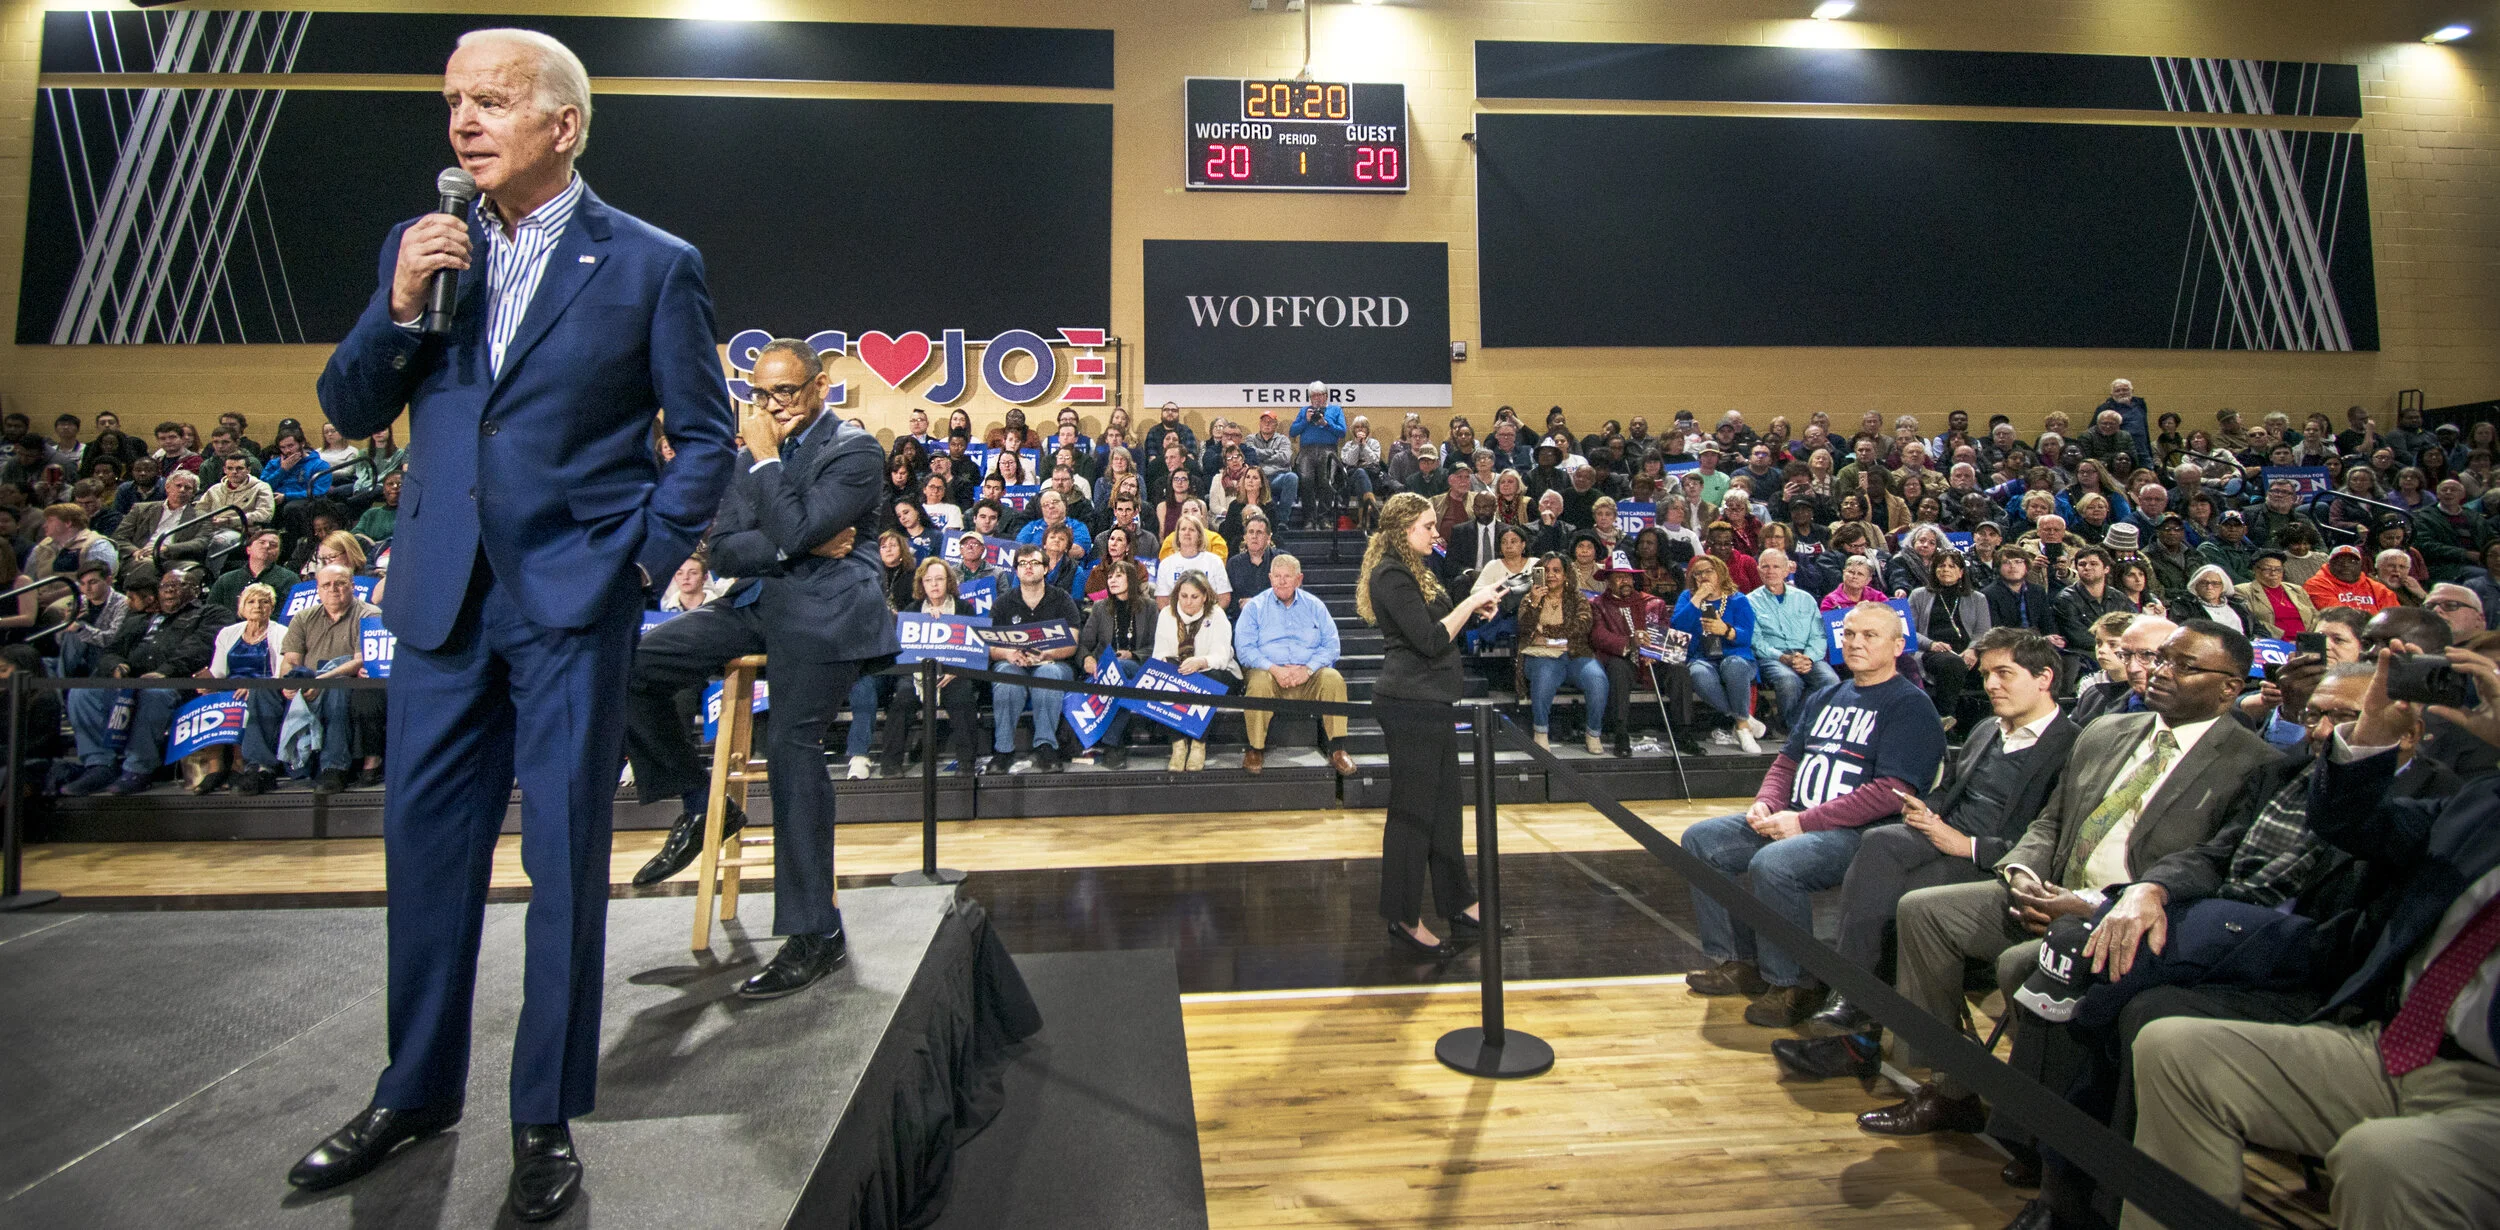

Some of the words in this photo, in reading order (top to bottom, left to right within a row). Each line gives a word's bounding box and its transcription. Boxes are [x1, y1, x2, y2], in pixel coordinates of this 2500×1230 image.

[1247, 83, 1347, 118] 20:20
[1195, 122, 1272, 140] WOFFORD
[1279, 133, 1317, 145] PERIOD
[1346, 125, 1397, 142] GUEST
[1207, 144, 1250, 178] 20
[1300, 151, 1307, 174] 1
[1356, 147, 1398, 180] 20
[1185, 295, 1409, 328] WOFFORD
[922, 327, 1106, 404] JOE
[1243, 388, 1356, 403] TERRIRS
[977, 587, 991, 595] FOR
[364, 629, 387, 637] SOUTH
[901, 621, 985, 648] BIDEN
[977, 624, 1066, 643] BIDEN
[955, 645, 984, 654] CAROLINA
[1146, 668, 1168, 680] SOUTH
[1168, 675, 1201, 694] CAROLINA
[177, 707, 201, 725] SOUTH
[201, 701, 248, 712] CAROLINA
[1810, 704, 1878, 745] IBEW
